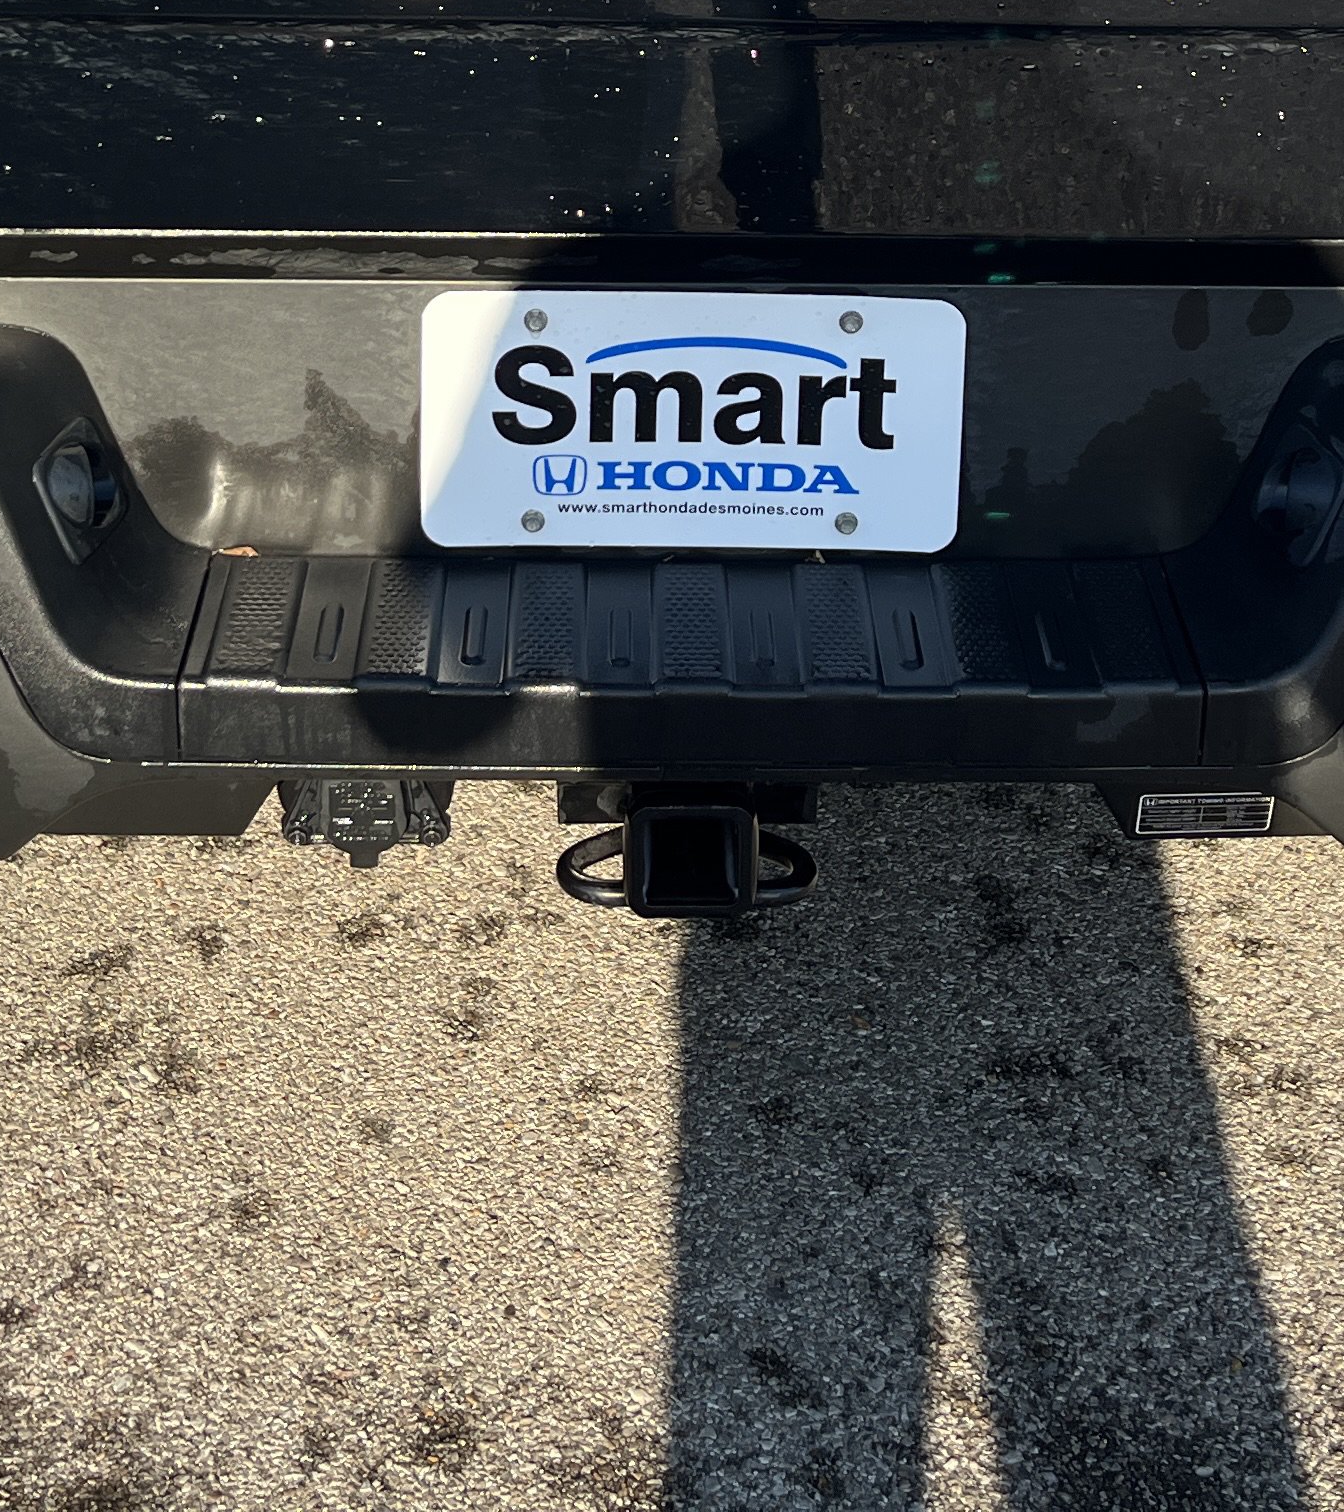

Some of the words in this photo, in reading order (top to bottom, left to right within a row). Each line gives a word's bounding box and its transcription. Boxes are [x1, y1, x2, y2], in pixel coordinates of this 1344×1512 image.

[492, 345, 897, 450] Smart
[597, 461, 859, 495] HONDA
[558, 501, 824, 517] www.smarthondadesmoines.com
